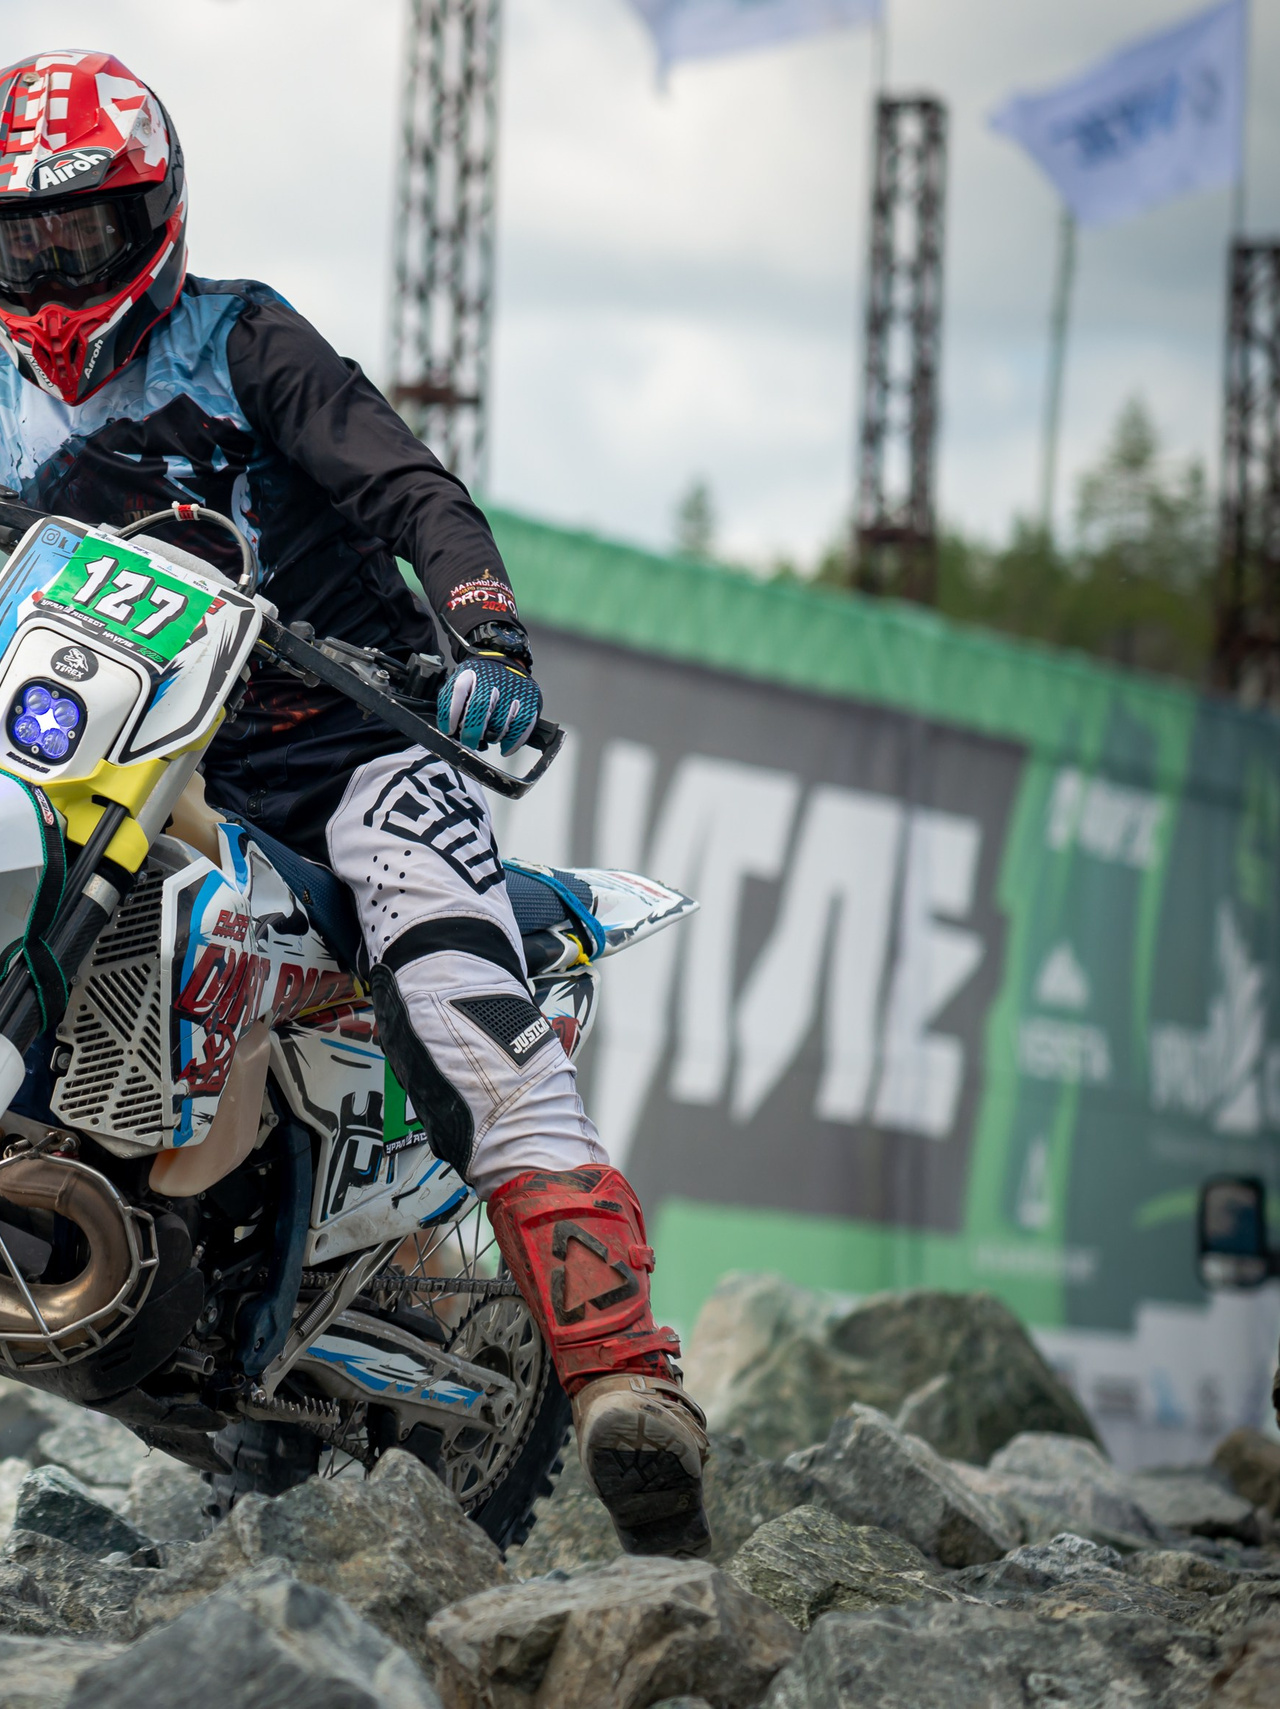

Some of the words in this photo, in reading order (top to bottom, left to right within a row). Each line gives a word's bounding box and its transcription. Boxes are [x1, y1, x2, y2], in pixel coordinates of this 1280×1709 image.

[38, 151, 107, 191] Airoh
[84, 339, 104, 379] Airoh
[72, 554, 190, 641] 127
[481, 600, 508, 612] 2024
